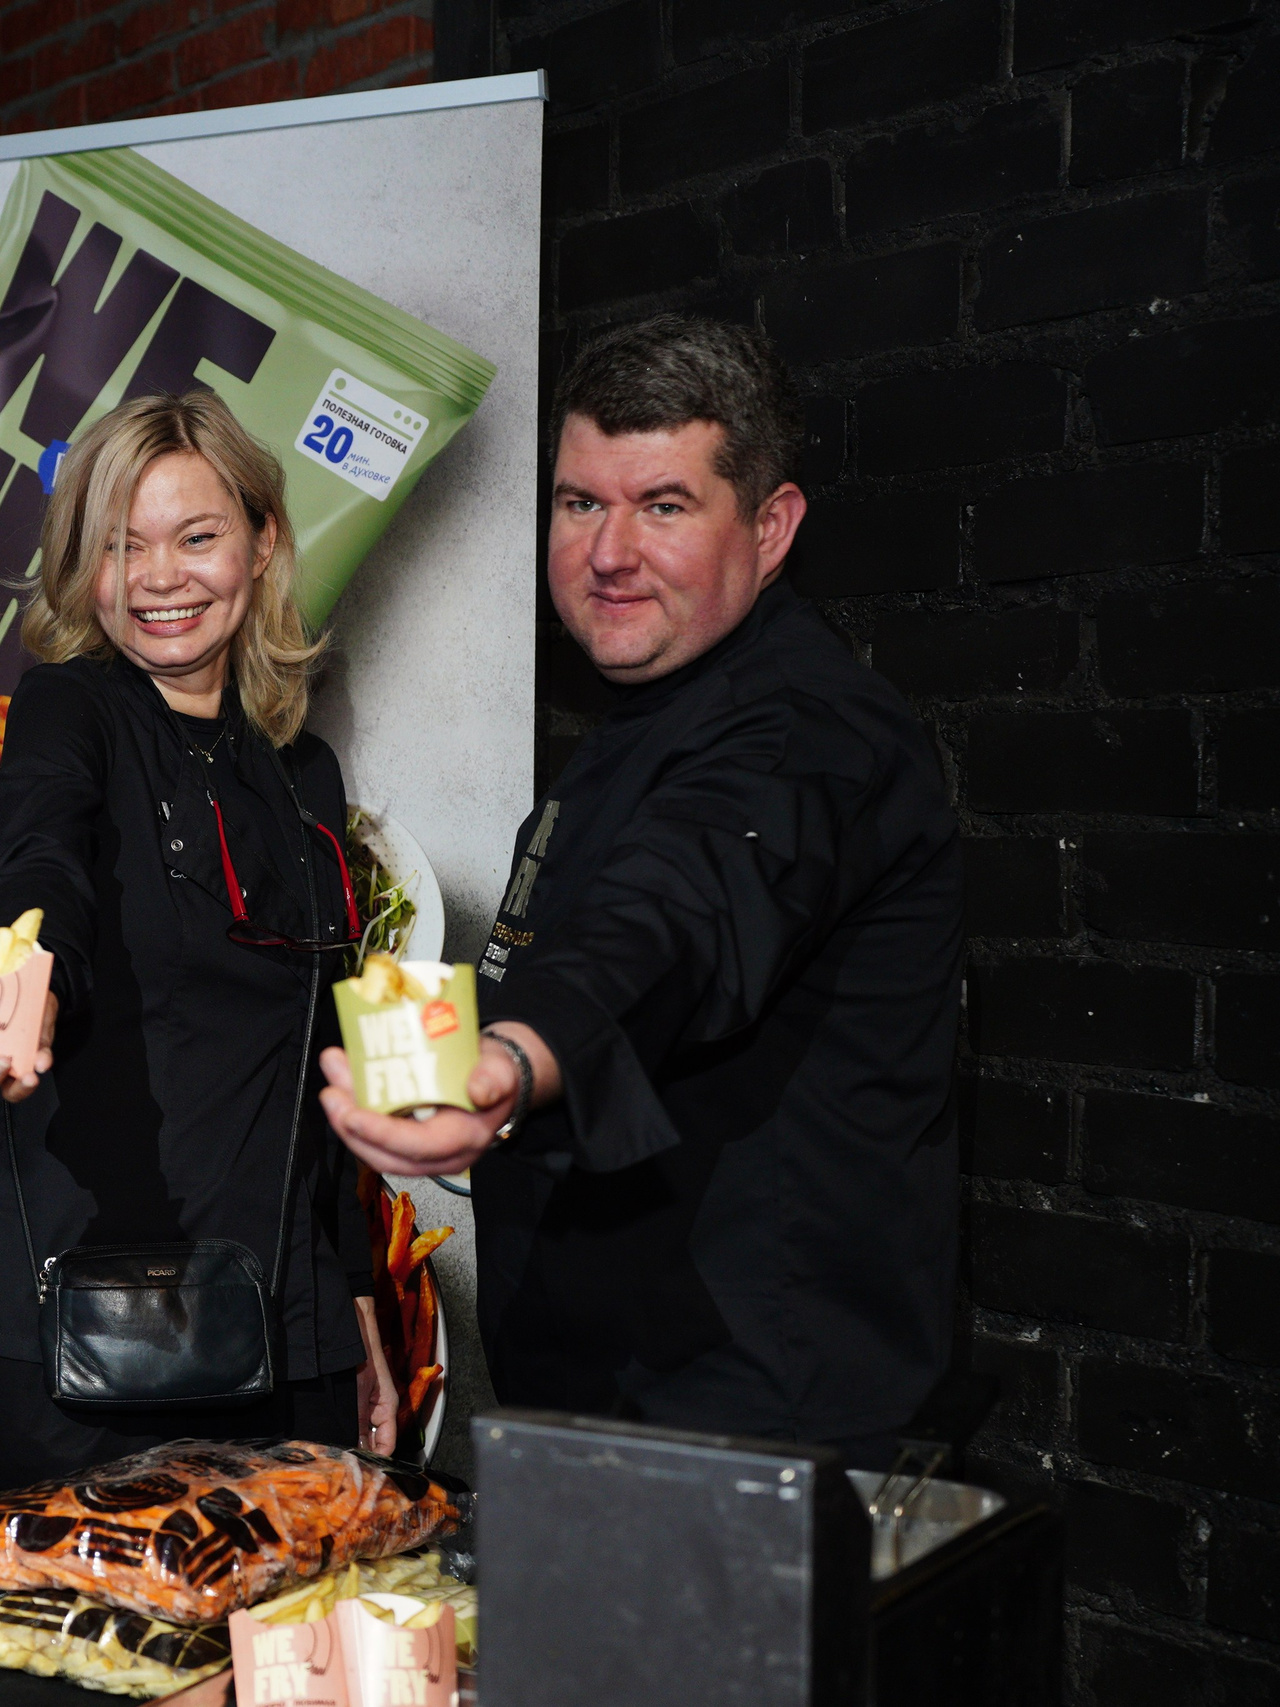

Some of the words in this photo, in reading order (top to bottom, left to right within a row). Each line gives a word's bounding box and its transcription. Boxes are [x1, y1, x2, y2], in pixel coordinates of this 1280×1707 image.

[302, 414, 354, 464] 20
[322, 398, 370, 432] ПОЛЕЗНАЯ
[369, 427, 408, 455] ГОТОВКА
[358, 1005, 422, 1058] WE
[363, 1052, 438, 1107] FRY
[147, 1268, 177, 1277] PICARD
[252, 1628, 295, 1667] WE
[254, 1662, 311, 1702] FRY
